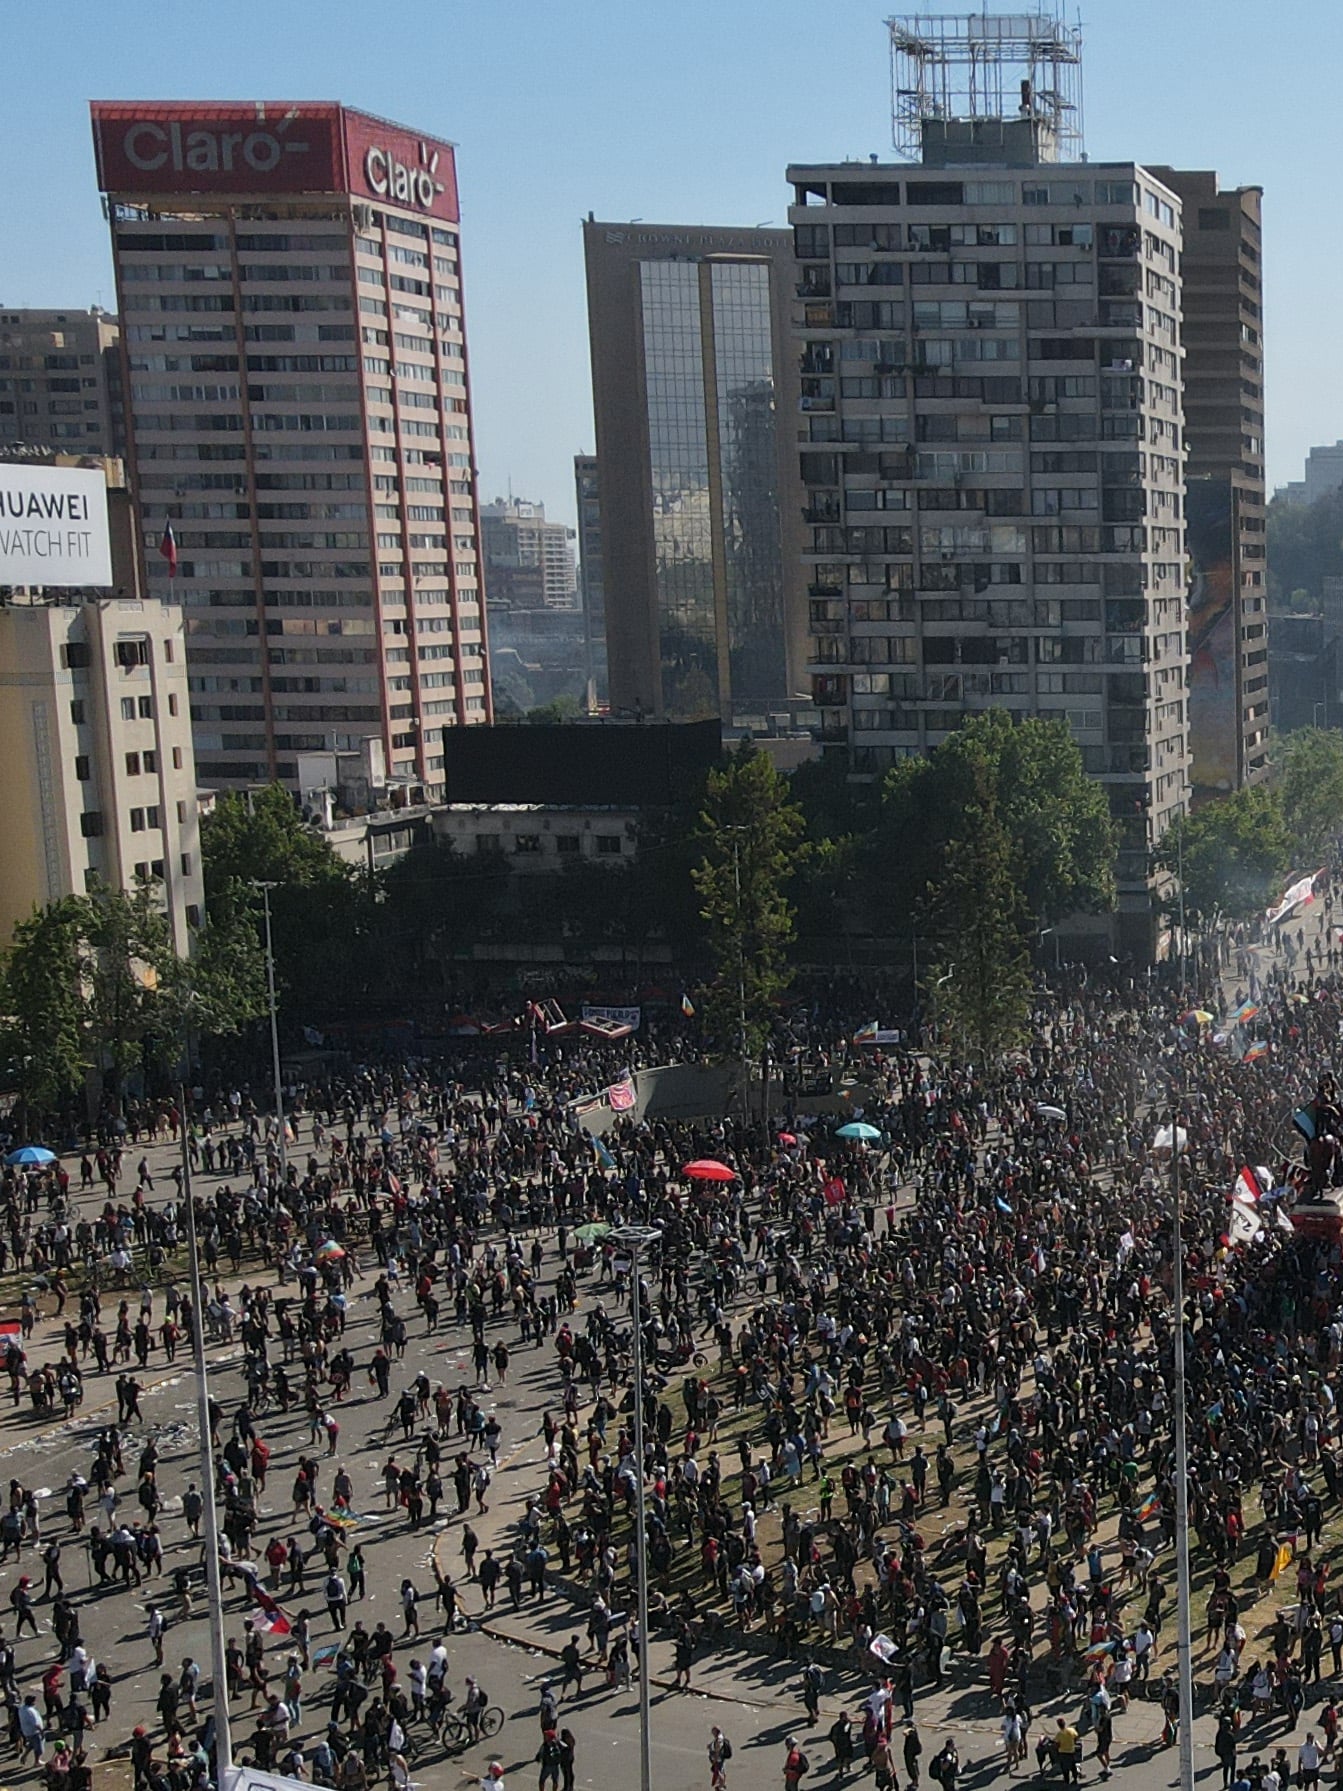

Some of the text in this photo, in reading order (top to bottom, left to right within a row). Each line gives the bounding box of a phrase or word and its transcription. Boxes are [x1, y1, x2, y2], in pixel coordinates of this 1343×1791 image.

[124, 120, 282, 172] Claro
[365, 145, 434, 208] Claro
[67, 531, 92, 558] FIT
